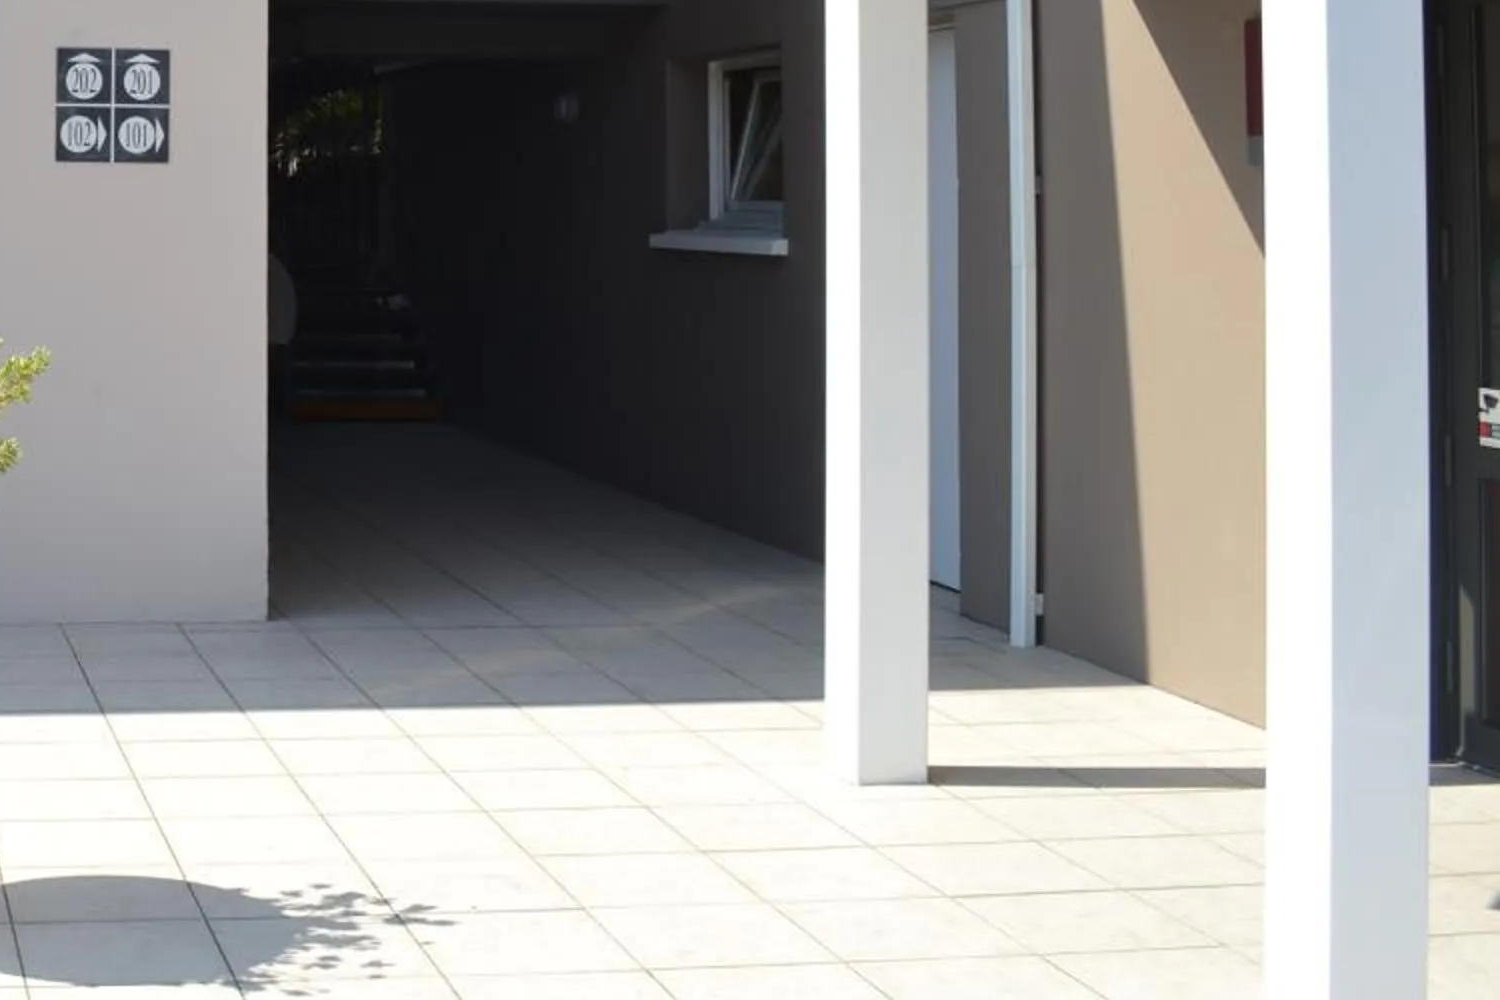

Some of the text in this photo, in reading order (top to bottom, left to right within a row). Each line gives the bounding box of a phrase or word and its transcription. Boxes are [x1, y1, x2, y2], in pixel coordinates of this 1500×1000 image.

[71, 67, 97, 93] 202
[129, 68, 153, 95] 201
[67, 121, 91, 147] 102
[125, 121, 148, 149] 101
